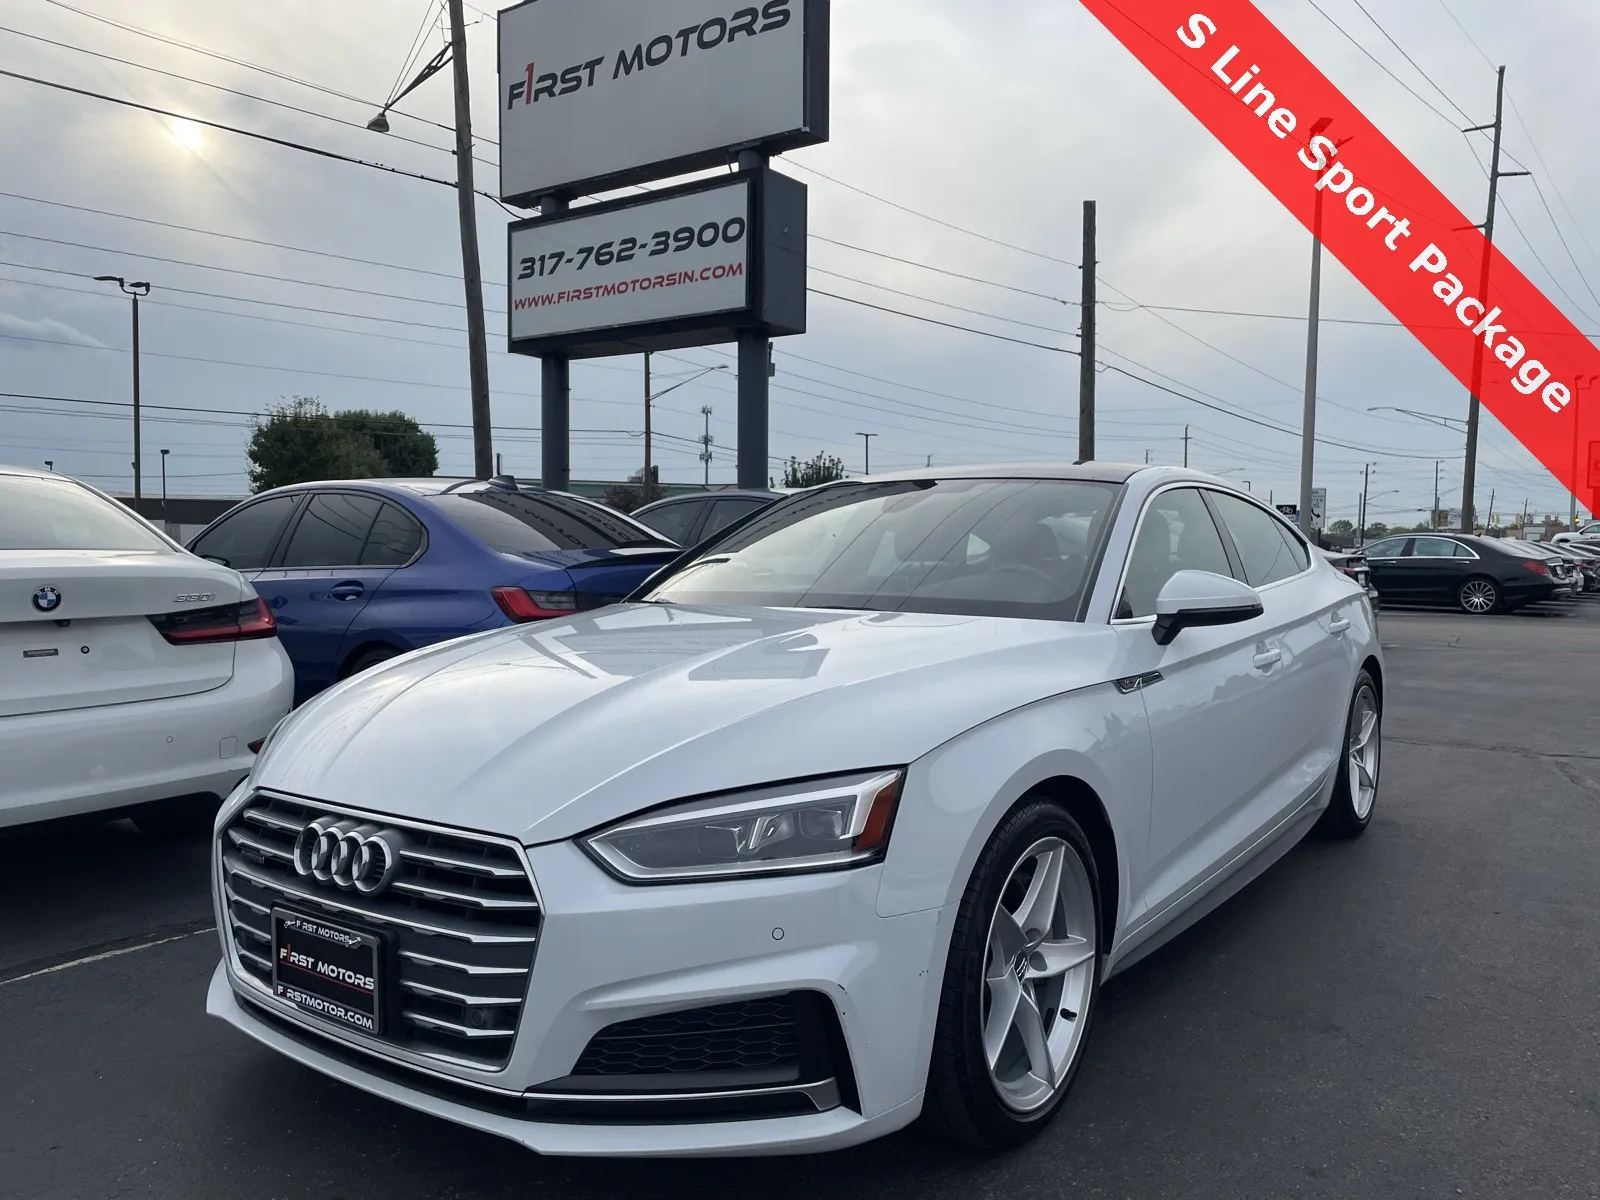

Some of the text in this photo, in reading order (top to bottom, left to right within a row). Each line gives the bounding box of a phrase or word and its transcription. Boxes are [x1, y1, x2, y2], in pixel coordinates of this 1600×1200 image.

[612, 0, 791, 80] MOTORS
[517, 216, 746, 280] 317-762-3900
[513, 262, 744, 311] WWW.FIRSTMOTORSIN.COM
[316, 960, 375, 990] MOTORS
